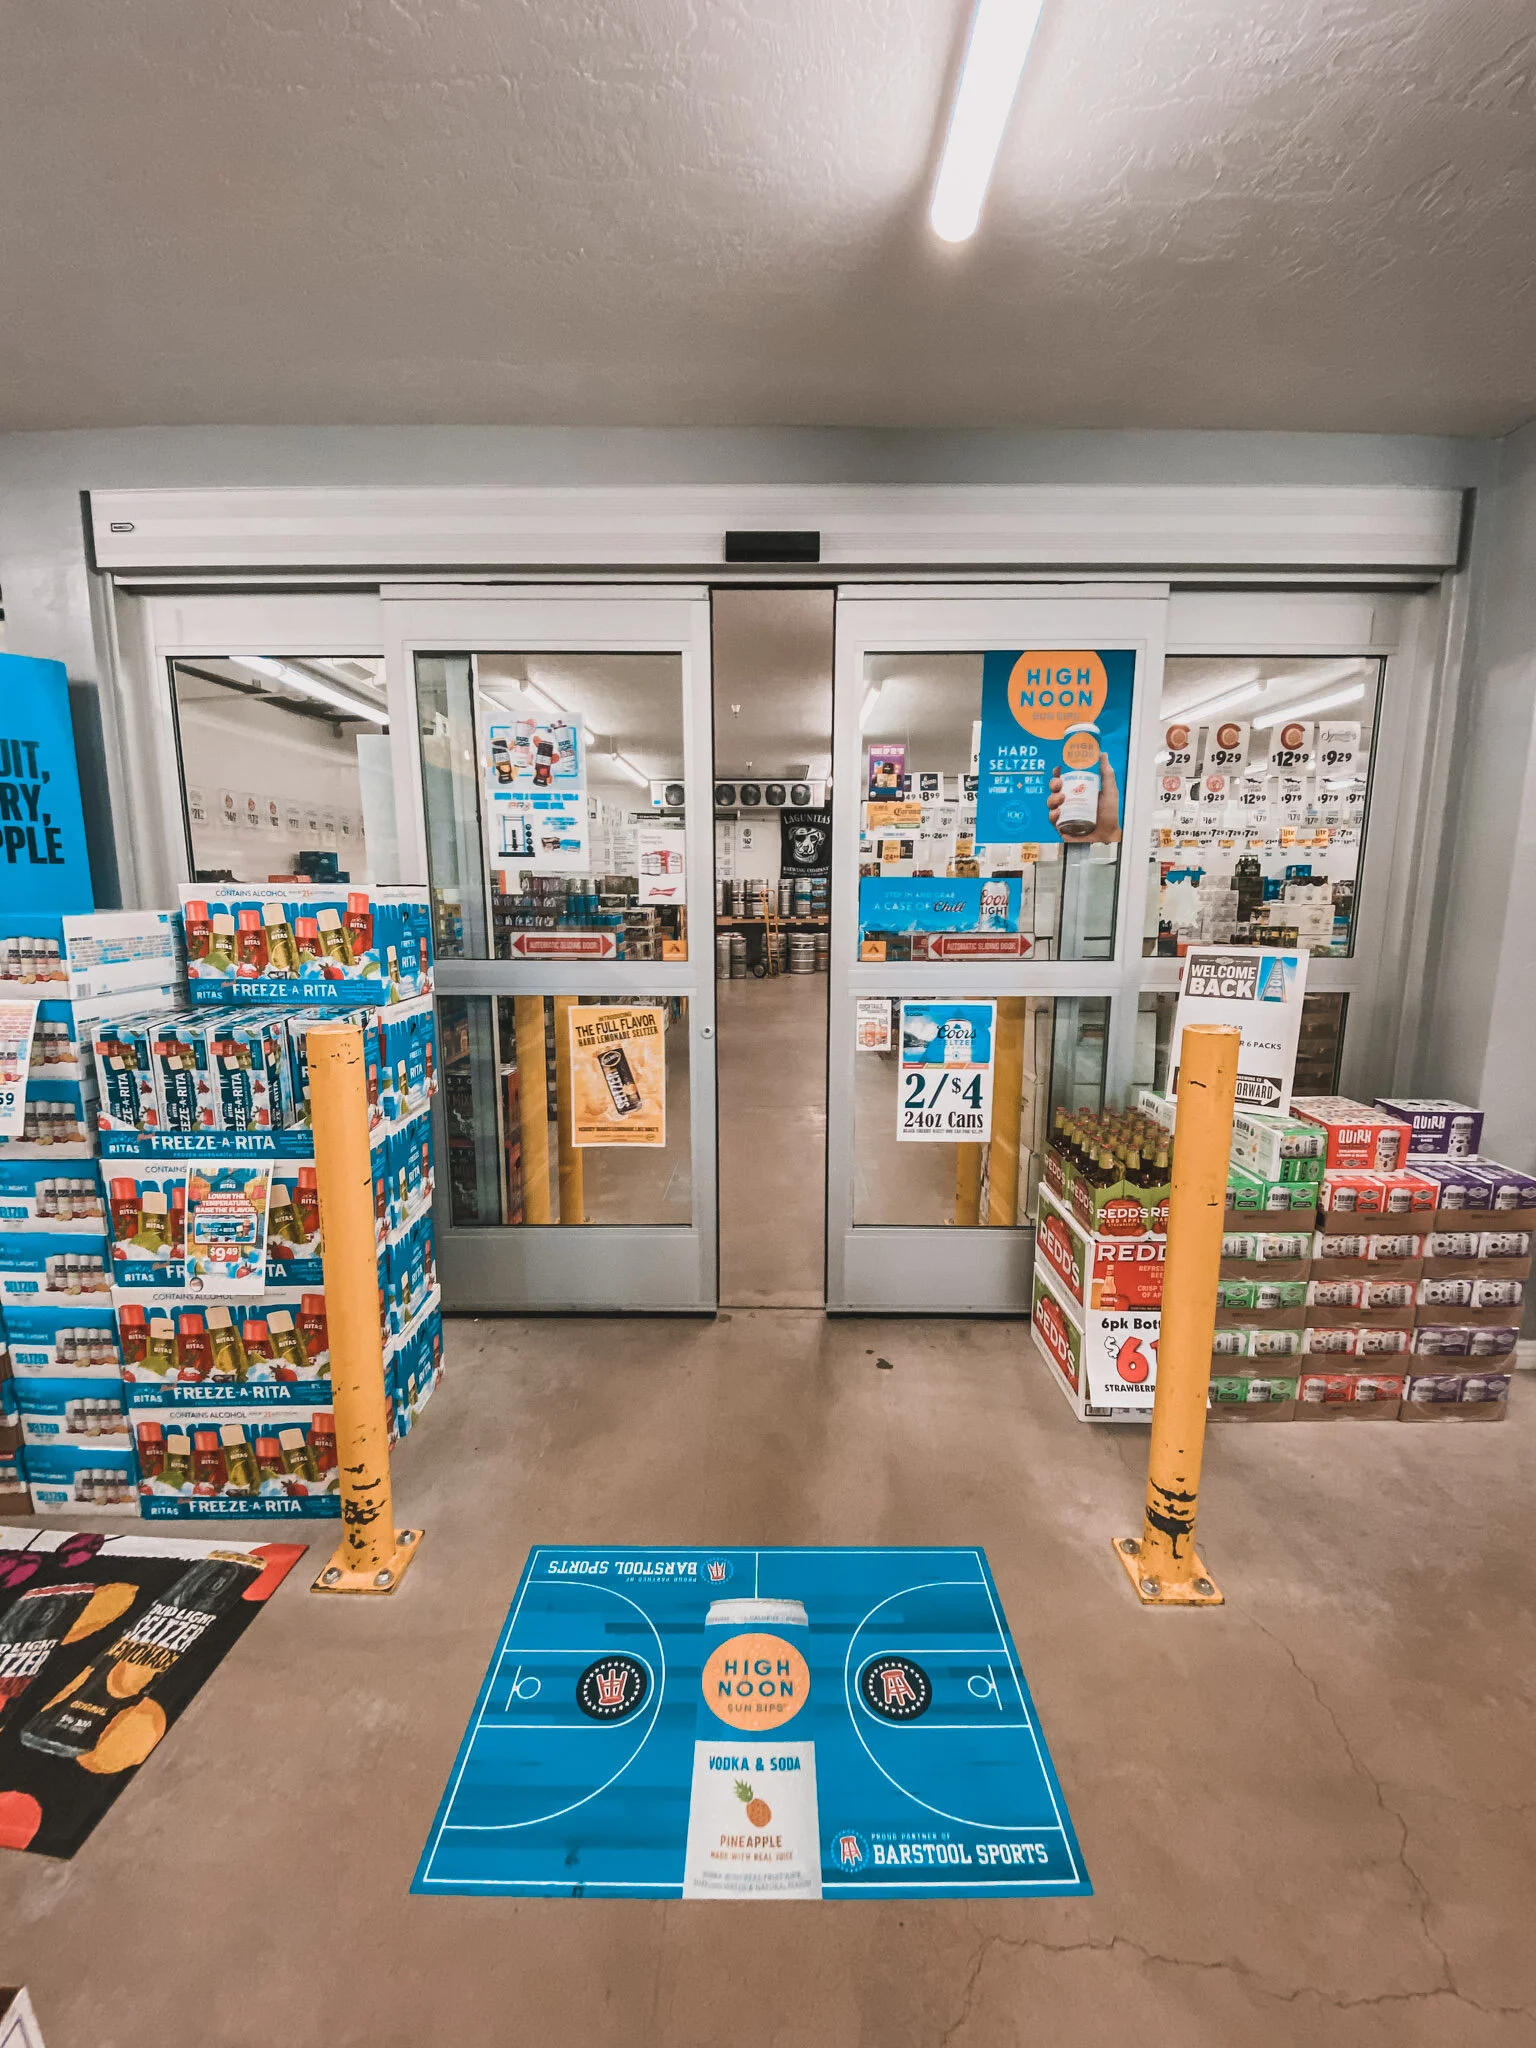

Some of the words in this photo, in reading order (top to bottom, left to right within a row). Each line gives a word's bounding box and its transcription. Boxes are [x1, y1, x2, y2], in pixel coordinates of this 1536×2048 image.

[1027, 668, 1091, 686] HIGH
[1020, 690, 1093, 707] NOON
[998, 746, 1038, 757] HARD
[1211, 750, 1242, 766] $929
[1321, 750, 1352, 766] $929
[989, 759, 1045, 771] SELTZER
[1272, 751, 1309, 767] $1299
[1160, 793, 1182, 803] $929
[1240, 794, 1266, 804] $1299
[1281, 793, 1302, 804] $979
[1318, 793, 1338, 804] $979
[783, 814, 831, 825] LAGUNITAS
[216, 889, 252, 898] CONTAINS
[252, 889, 287, 897] ALCOHOL
[884, 902, 913, 911] CASE
[915, 902, 930, 911] OF
[934, 900, 967, 913] Chill
[981, 907, 1008, 915] LIGHT
[401, 957, 417, 968] RITA
[1191, 964, 1257, 980] WELCOME
[1189, 977, 1256, 998] BACK
[196, 990, 223, 1000] RITAS
[576, 1024, 596, 1038] THE
[596, 1020, 619, 1034] FULL
[620, 1014, 656, 1031] FLAVOR
[937, 1024, 977, 1039] Coors
[578, 1037, 596, 1047] HARD
[598, 1031, 630, 1044] LEMONADE
[633, 1026, 658, 1038] SELTZER
[1253, 1041, 1282, 1051] PACKS
[1237, 1082, 1273, 1100] ORWARD
[904, 1110, 942, 1128] 24oz
[948, 1111, 983, 1129] Cans
[1413, 1115, 1446, 1129] QUIRK
[1338, 1129, 1372, 1144] QUIRK
[109, 1144, 140, 1154] RITAS
[145, 1166, 187, 1174] CONTAINS
[1096, 1206, 1149, 1219] REDD'S
[1040, 1220, 1080, 1288] REDD'S
[124, 1273, 154, 1282] RITAS
[1101, 1318, 1129, 1331] 6pk
[1036, 1300, 1076, 1376] REDD'S
[133, 1395, 163, 1403] RITAS
[151, 1507, 179, 1515] RITAS
[548, 1560, 609, 1574] SPORTS
[617, 1561, 697, 1575] BARSTOOL
[175, 1608, 217, 1627] LIGHT
[127, 1614, 206, 1653] SELTZER
[10, 1639, 59, 1653] LIGHT
[724, 1659, 790, 1676] HIGH
[718, 1681, 794, 1697] NOON
[727, 1704, 753, 1713] SUN
[709, 1756, 749, 1771] VODKA
[755, 1757, 764, 1771] &
[770, 1756, 801, 1771] SODA
[720, 1834, 782, 1848] PINEAPPLE
[871, 1832, 897, 1841] PROUD
[901, 1832, 938, 1841] PARTNER
[873, 1844, 972, 1865] BARSTOOL
[978, 1843, 1049, 1865] SPORTS
